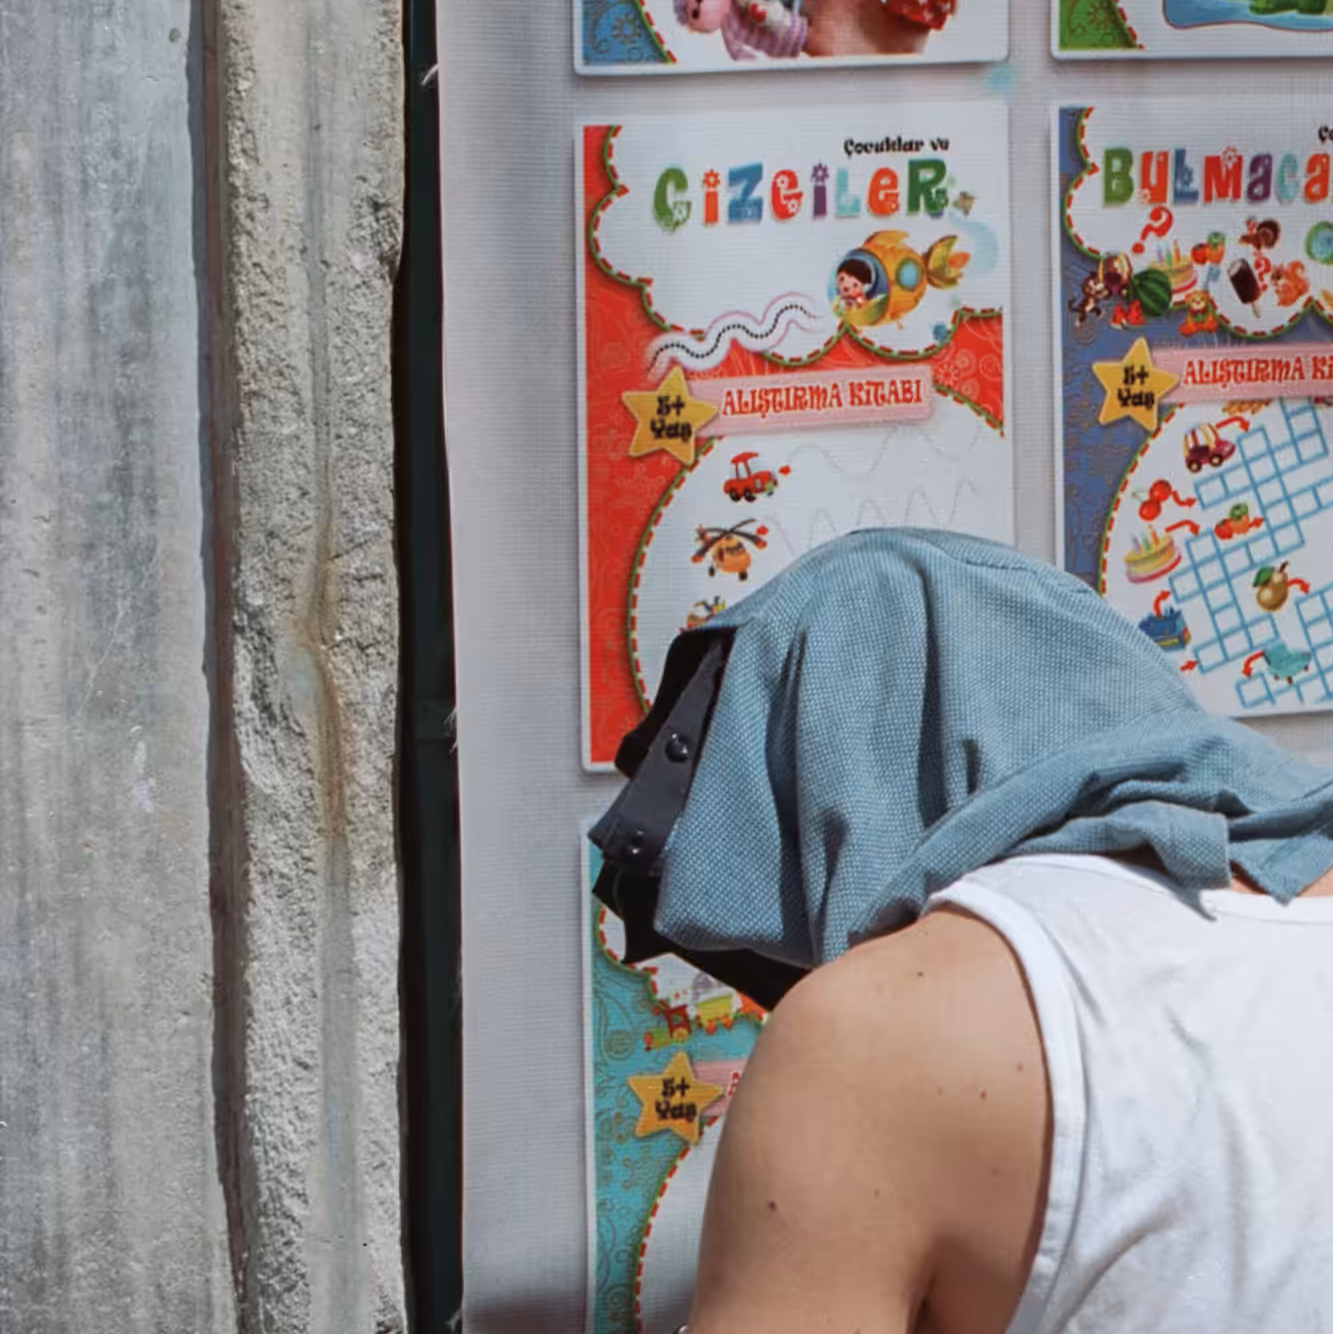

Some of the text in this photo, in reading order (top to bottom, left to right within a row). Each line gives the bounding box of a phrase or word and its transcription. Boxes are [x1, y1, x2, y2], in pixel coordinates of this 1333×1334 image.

[1122, 367, 1149, 386] 5+
[656, 396, 685, 416] 5+
[662, 1079, 690, 1098] 5+
